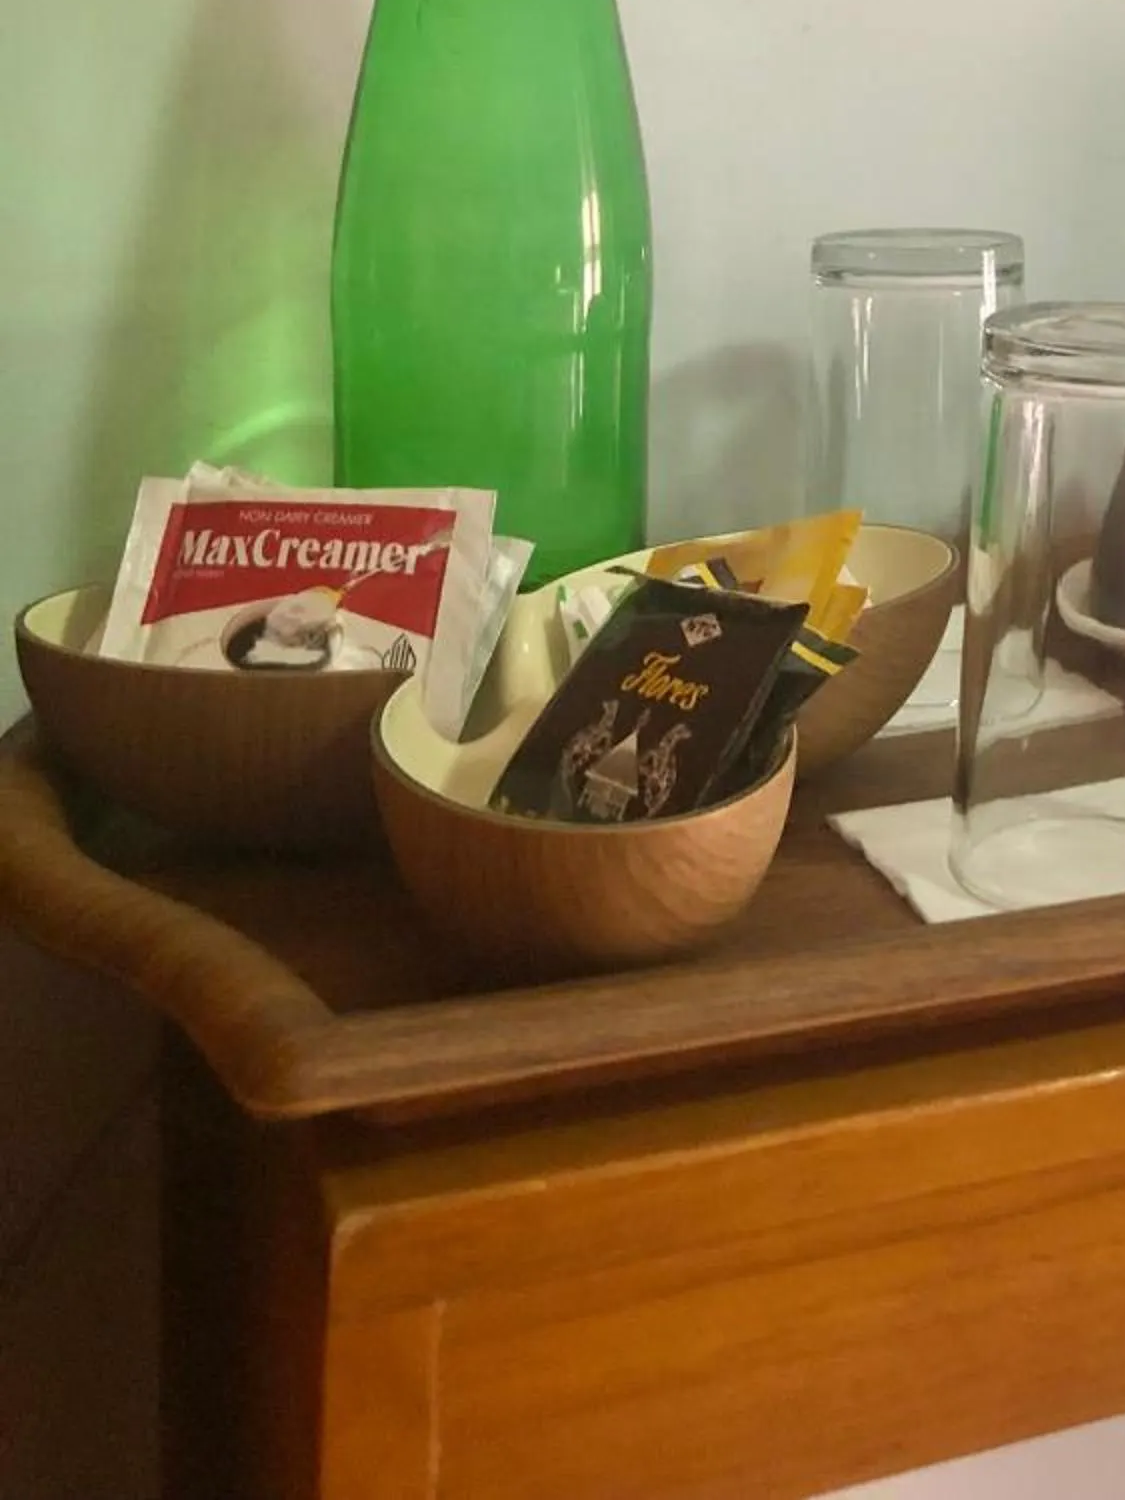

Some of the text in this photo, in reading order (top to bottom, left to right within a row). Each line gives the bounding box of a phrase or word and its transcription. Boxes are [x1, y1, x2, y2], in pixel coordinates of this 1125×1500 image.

[239, 509, 273, 523] NON
[313, 511, 373, 525] CREAMER
[178, 528, 429, 575] MaxCreamer
[620, 651, 709, 711] Flores
